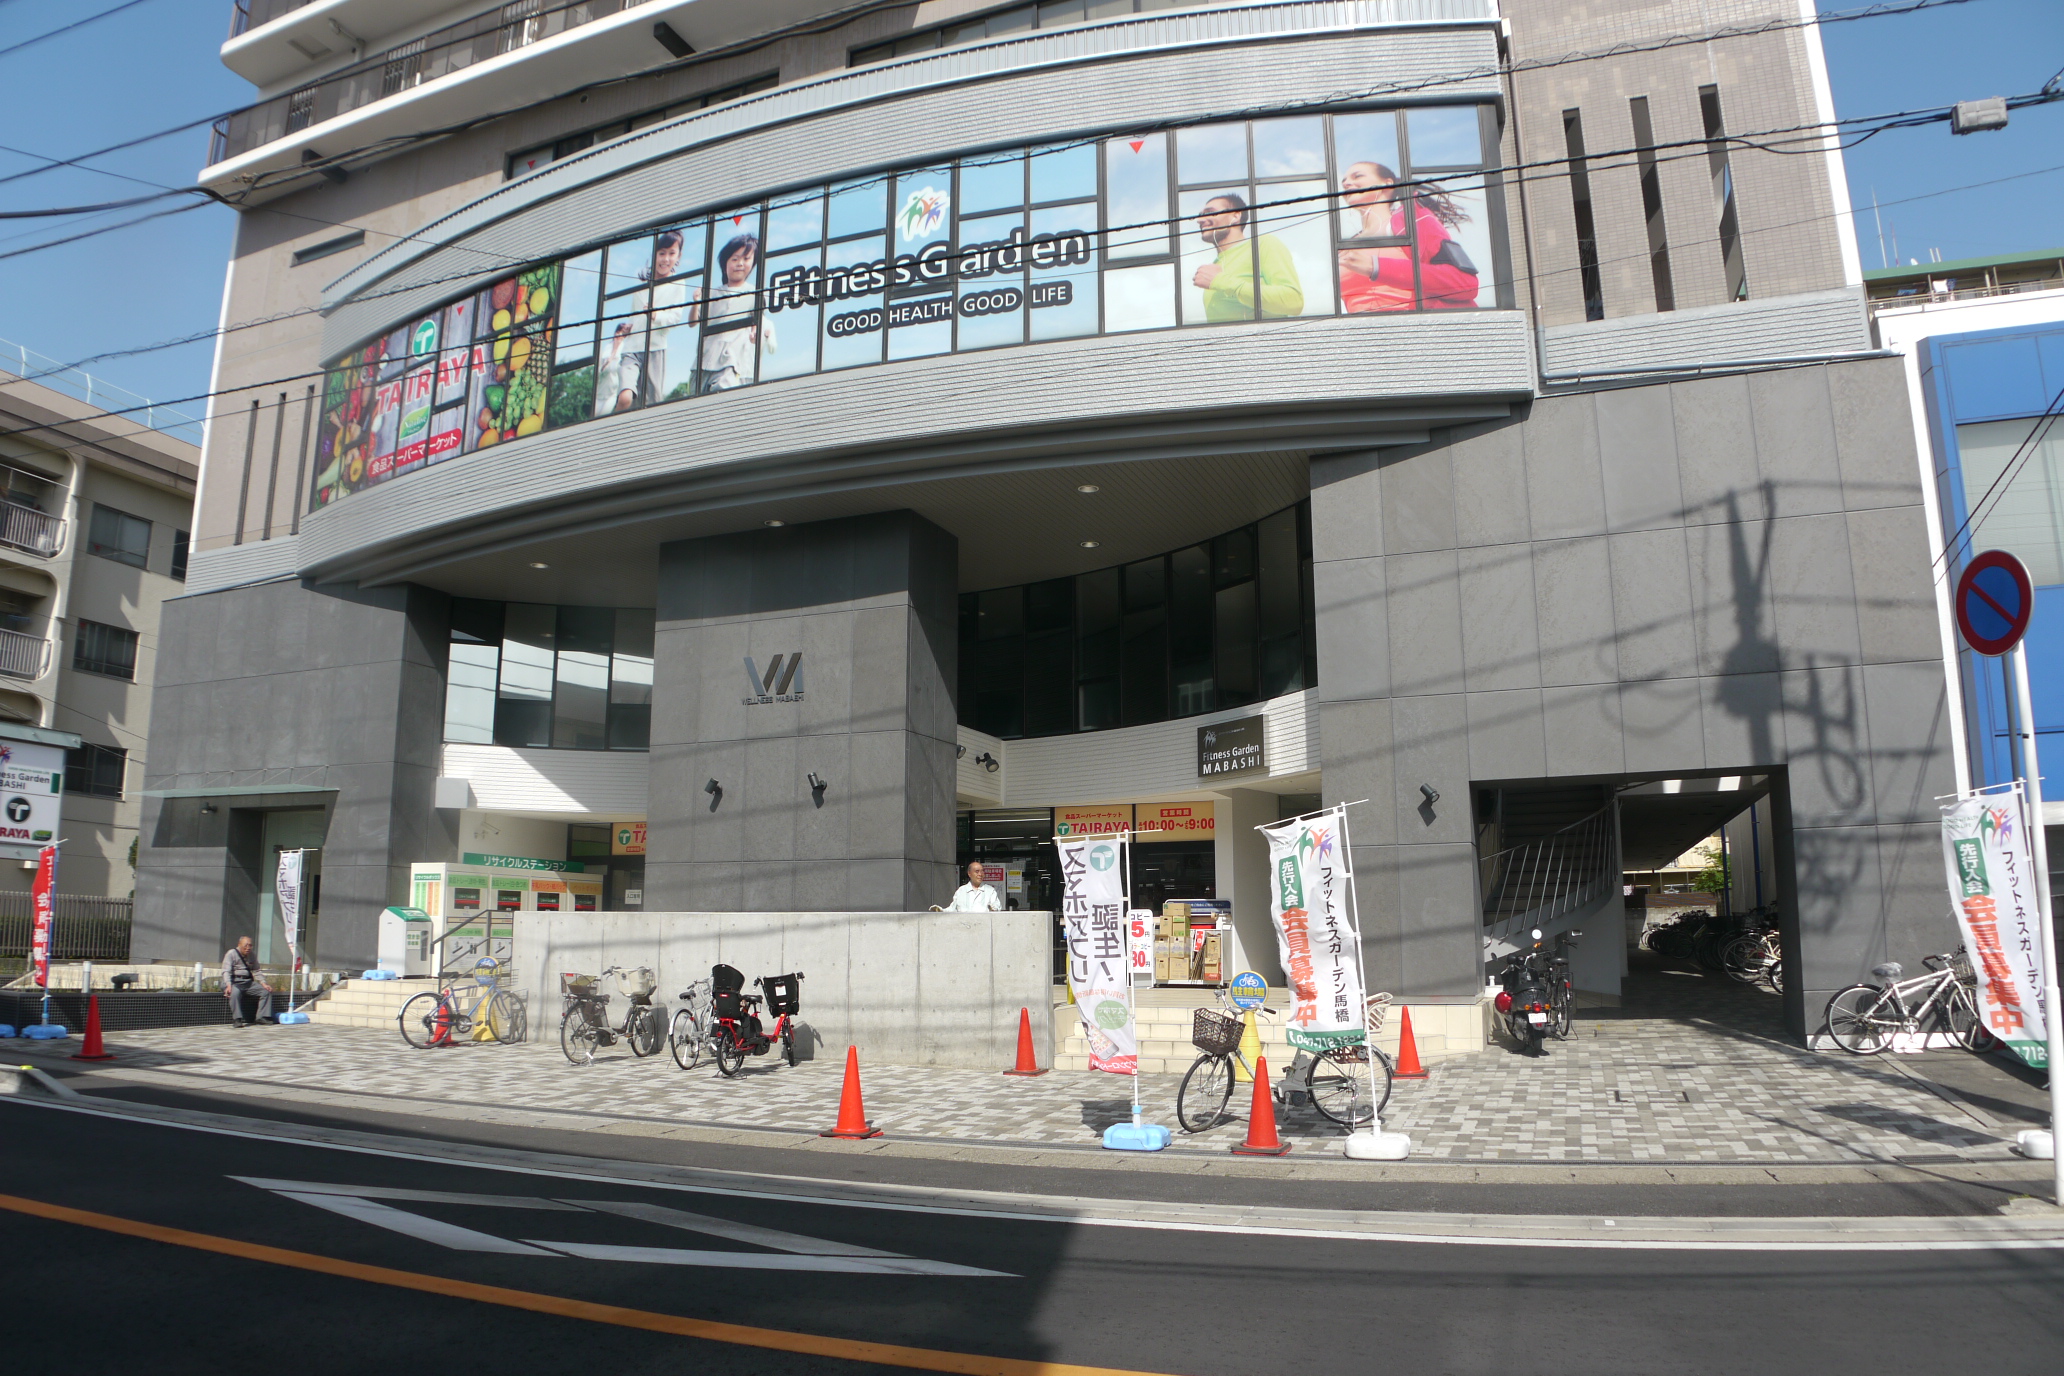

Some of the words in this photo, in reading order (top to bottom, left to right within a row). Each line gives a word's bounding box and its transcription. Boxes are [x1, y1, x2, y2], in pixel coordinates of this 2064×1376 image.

[832, 313, 881, 332] GOOD
[889, 301, 952, 324] HEALTH
[963, 293, 1017, 312] GOOD
[1033, 286, 1067, 303] LIFE
[376, 347, 486, 414] TAIRAYA
[372, 432, 457, 474] 食品スーパーマーケット
[1203, 750, 1231, 761] Fitness
[1232, 744, 1260, 756] Garden
[1203, 755, 1260, 775] MABASHI
[19, 773, 50, 784] Garden
[1071, 821, 1130, 834] TAIRAYA
[483, 855, 567, 872] リサイクルステーション
[1282, 861, 1299, 907] 先行入会
[1960, 843, 1984, 894] 先行入会
[1280, 907, 1318, 1027] 会員募集中
[1321, 866, 1350, 1023] フィットネスガーデン馬橋
[1961, 895, 2025, 1035] 会員募集中
